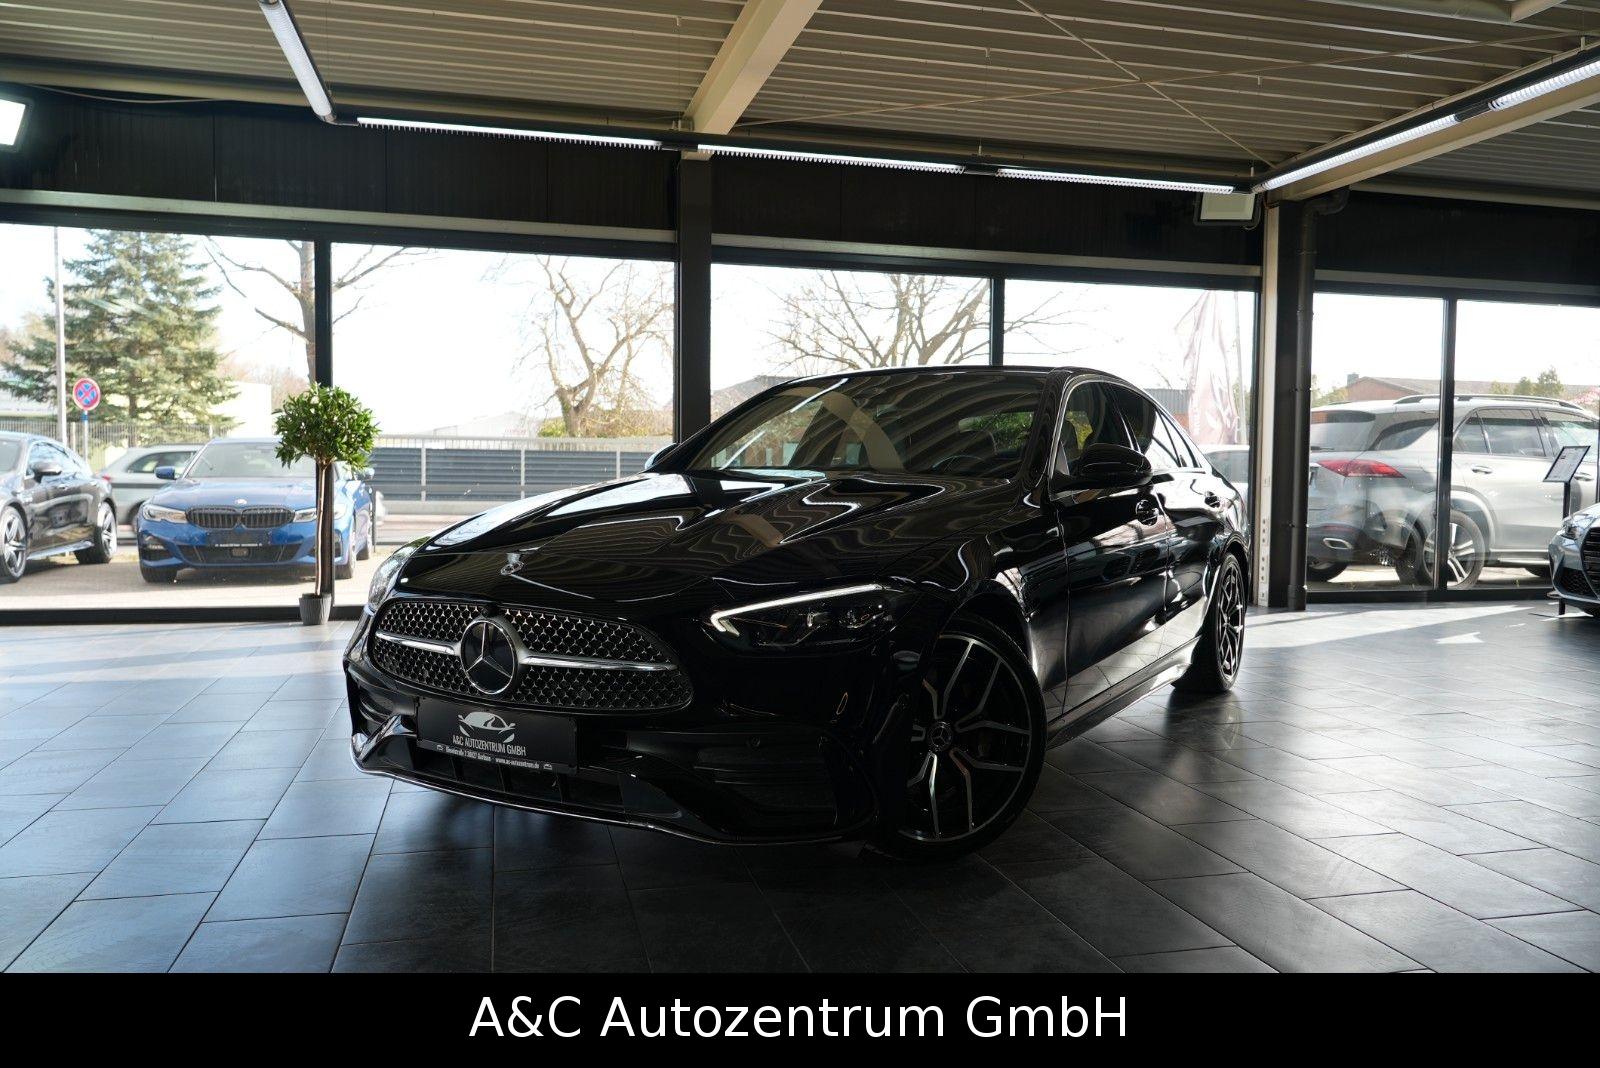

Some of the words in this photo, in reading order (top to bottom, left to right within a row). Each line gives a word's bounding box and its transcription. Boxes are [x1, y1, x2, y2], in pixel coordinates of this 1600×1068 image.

[452, 735, 464, 746] A&C
[464, 738, 506, 754] AUTOZENTRUM
[506, 744, 527, 756] GMBH
